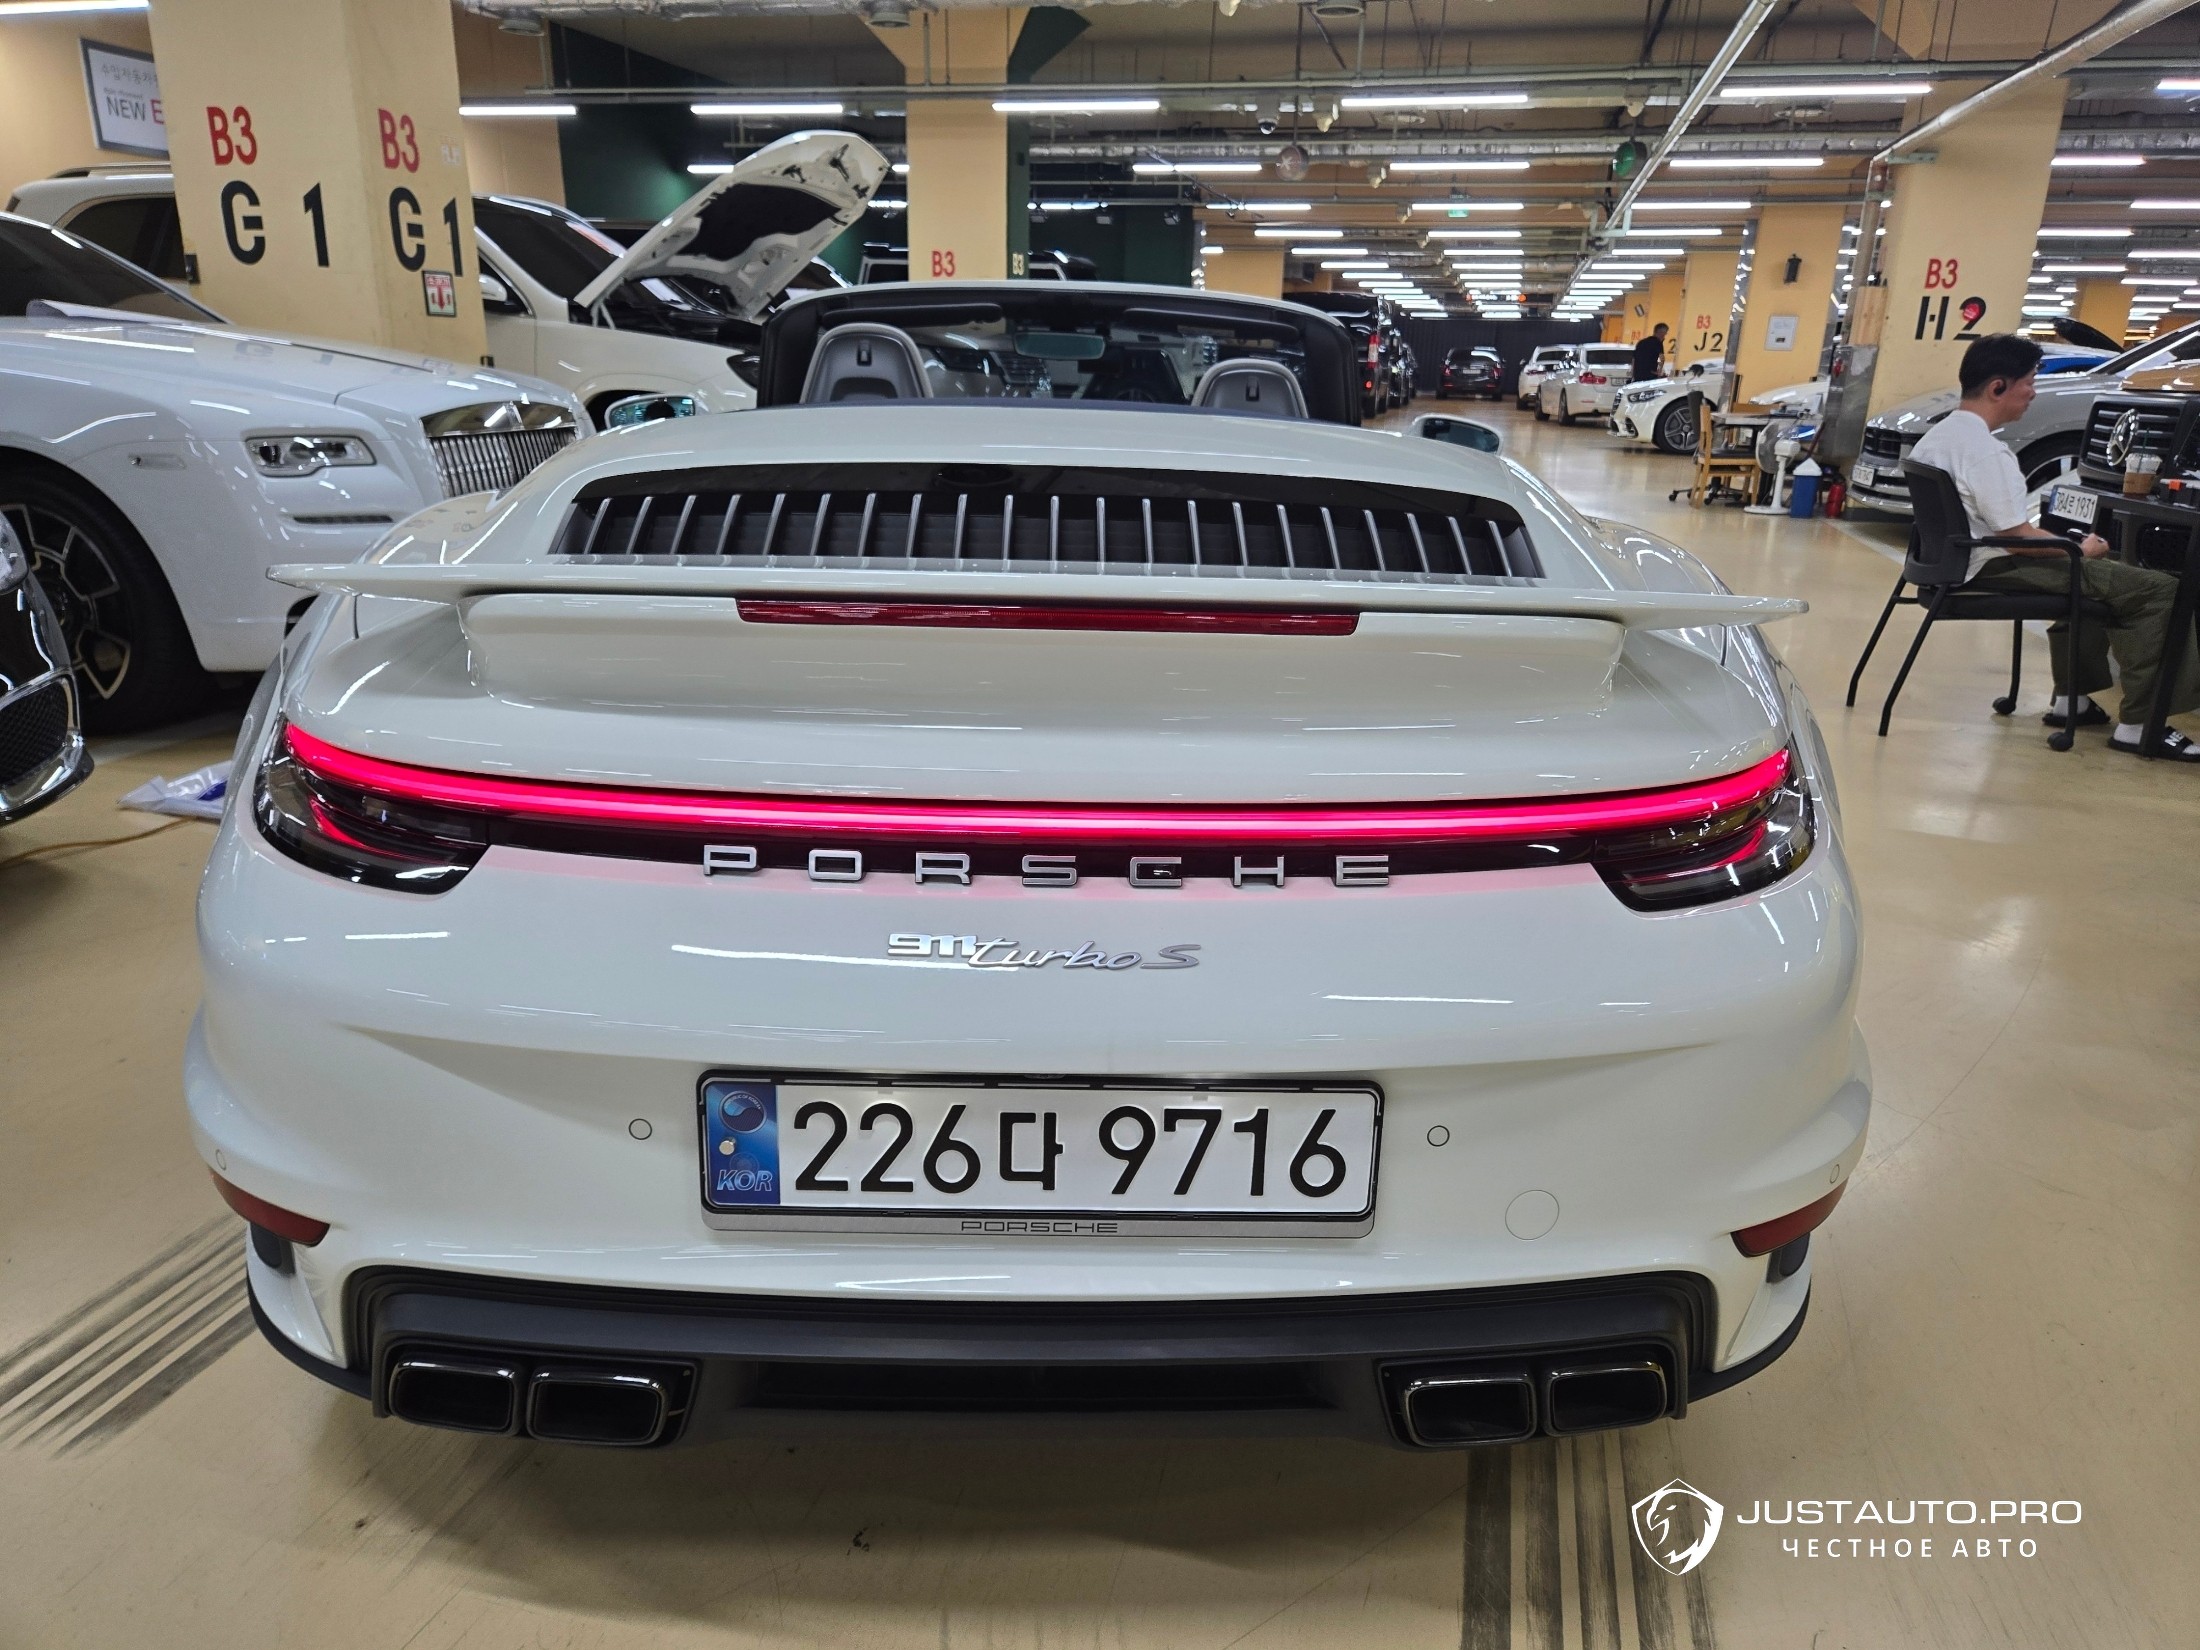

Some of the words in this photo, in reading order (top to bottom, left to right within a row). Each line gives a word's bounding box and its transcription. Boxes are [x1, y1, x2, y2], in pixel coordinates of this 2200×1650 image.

[106, 96, 147, 121] NEW
[206, 105, 258, 166] B3
[378, 108, 420, 173] B3
[932, 250, 955, 277] B3
[1012, 253, 1025, 276] B3
[1923, 258, 1959, 290] B3
[1696, 315, 1712, 330] B3
[1667, 338, 1677, 354] 2
[1694, 332, 1724, 352] J2
[703, 844, 1390, 889] PORSCHE
[887, 932, 977, 956] 911
[967, 936, 1142, 971] turbo
[1098, 1105, 1347, 1198] 9716
[716, 1169, 773, 1192] KOR
[961, 1221, 1118, 1233] PORSCHE
